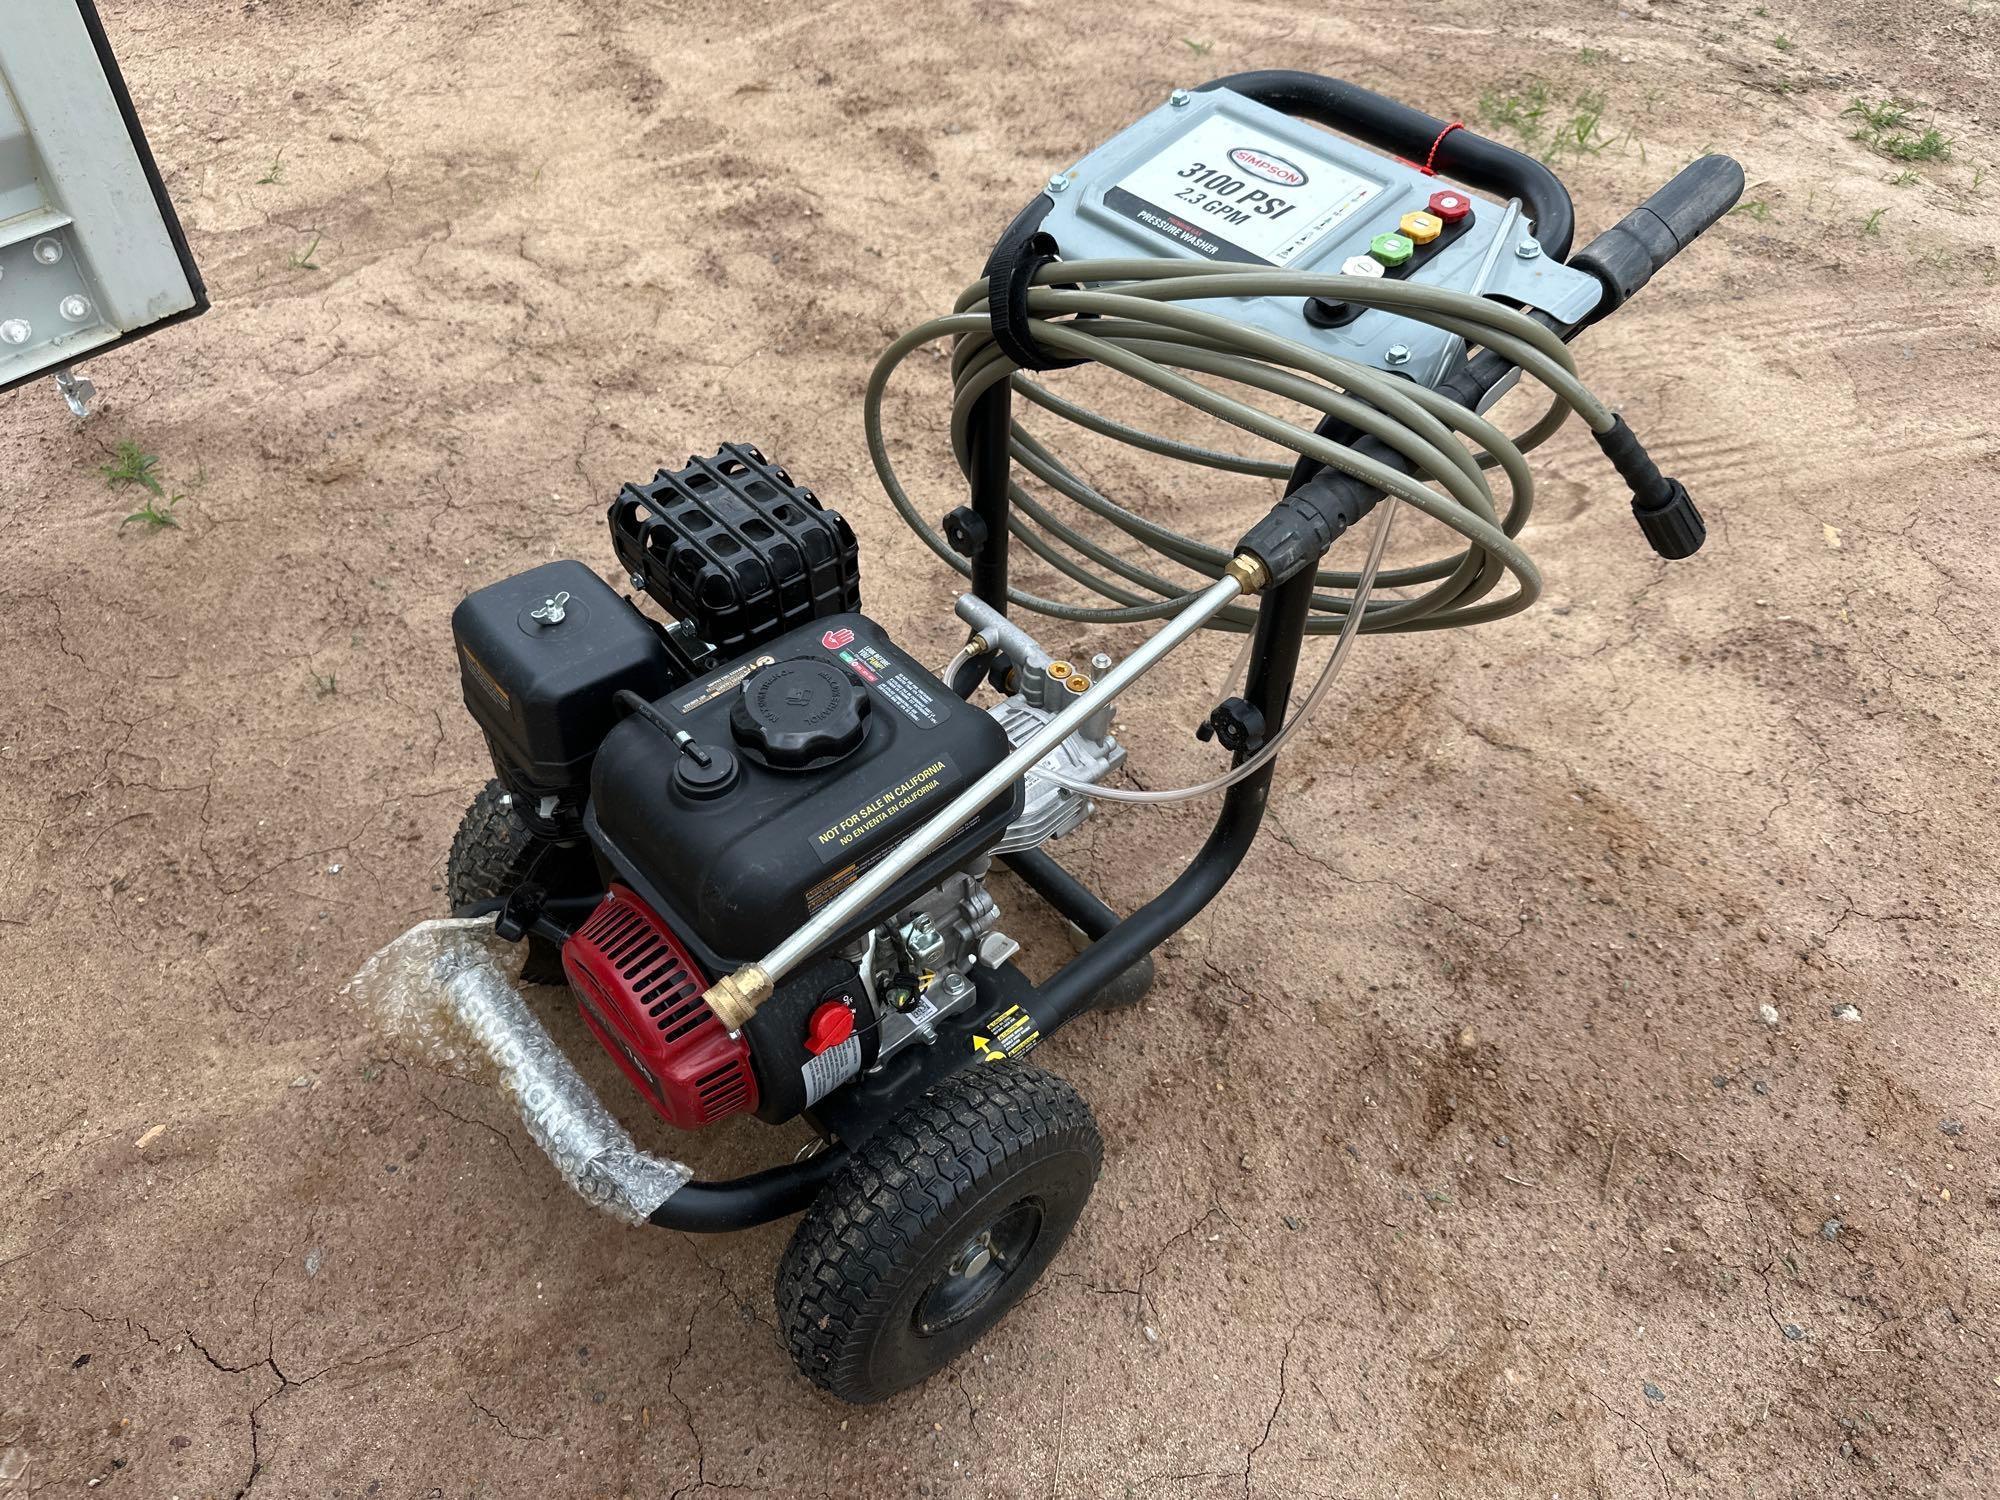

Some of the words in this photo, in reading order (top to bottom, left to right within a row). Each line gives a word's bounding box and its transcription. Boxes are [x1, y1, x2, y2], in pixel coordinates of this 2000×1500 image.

[1177, 162, 1246, 196] 3100
[1235, 189, 1297, 220] PSI
[1235, 151, 1299, 184] SIMPSON
[1137, 209, 1181, 237] PRESSURE
[1179, 231, 1220, 255] WASHER
[1174, 187, 1208, 205] 2.3
[1202, 200, 1252, 226] GPM
[818, 828, 841, 845] NOT
[839, 815, 861, 832] FOR
[859, 801, 885, 819] SALE
[883, 793, 896, 804] IN
[894, 761, 946, 797] CALIFORNIA
[839, 835, 853, 846] NO
[852, 827, 865, 838] EN
[864, 813, 889, 833] VENTA
[888, 805, 900, 816] EN
[898, 779, 940, 809] CALIFORNIA
